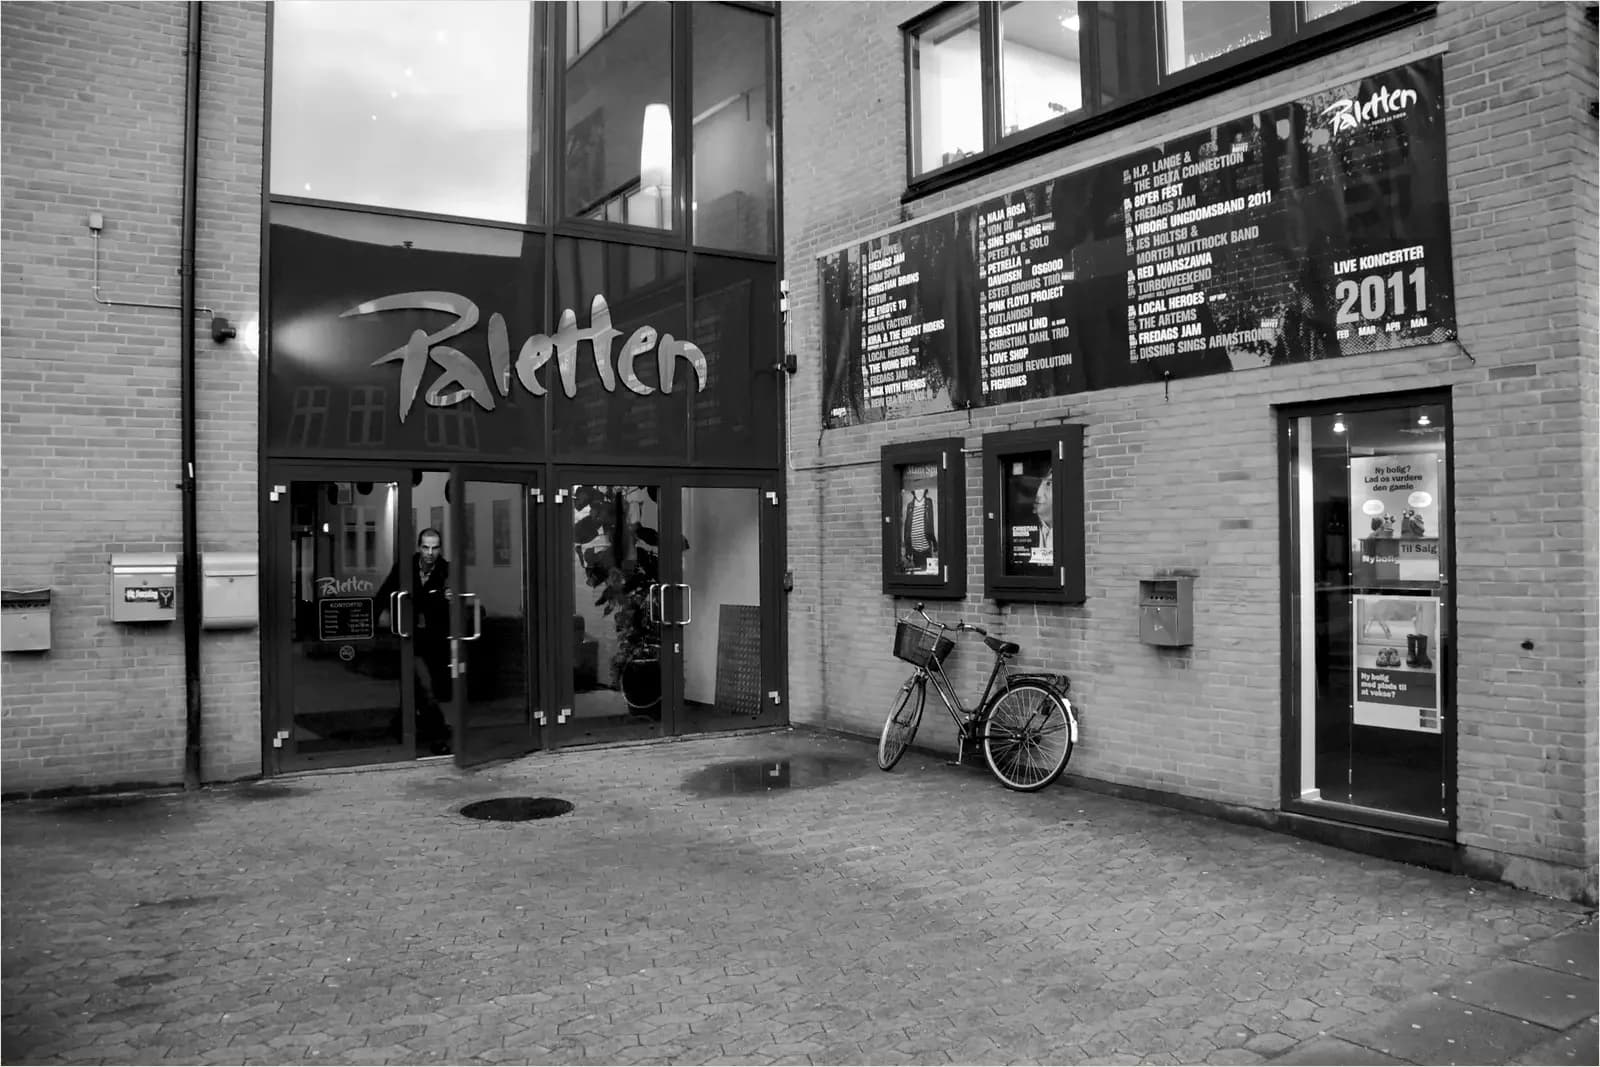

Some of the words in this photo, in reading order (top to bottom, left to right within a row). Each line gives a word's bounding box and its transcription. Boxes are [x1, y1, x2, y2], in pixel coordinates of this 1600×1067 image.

[1320, 85, 1417, 136] Paletten
[1133, 164, 1149, 179] H.P.
[1152, 153, 1182, 174] LANGE
[1184, 150, 1192, 163] &
[1134, 178, 1151, 193] THE
[1153, 170, 1180, 187] DELTA
[1182, 151, 1244, 178] CONNECTION
[1134, 192, 1160, 208] 80'ER
[1161, 183, 1183, 199] FEST
[1006, 202, 1026, 218] ROSA
[1135, 200, 1174, 222] FREDAGS
[1176, 194, 1196, 210] JAM
[1135, 218, 1168, 236] VIBORG
[1170, 197, 1245, 227] UNGDOMSBAND
[1247, 190, 1272, 208] 2011
[987, 222, 1002, 236] VON
[987, 235, 1004, 249] SING
[1005, 229, 1022, 244] SING
[1023, 223, 1041, 238] SING
[1136, 237, 1150, 251] JES
[1153, 227, 1188, 246] HOLTSØ
[1190, 225, 1199, 237] &
[987, 246, 1009, 261] PETER
[1020, 241, 1028, 252] G.
[1029, 235, 1049, 250] SOLO
[1136, 247, 1174, 265] MORTEN
[1176, 232, 1228, 256] WITTROCK
[1231, 226, 1259, 244] BAND
[893, 252, 905, 265] JAM
[988, 256, 1022, 274] PETRELLA
[1137, 265, 1154, 280] RED
[1156, 251, 1213, 276] WARSZAWA
[1334, 257, 1358, 275] LIVE
[1359, 245, 1425, 271] KONCERTER
[988, 269, 1022, 287] DAVIDSEN
[1031, 258, 1063, 276] OSGOOD
[1138, 267, 1212, 294] TURBOWEEKEND
[988, 285, 1009, 300] ESTER
[1042, 272, 1060, 287] TRIO
[1335, 266, 1427, 325] 2011
[898, 299, 907, 311] TO
[988, 299, 1005, 313] PINK
[1006, 293, 1029, 309] FLOYD
[1030, 285, 1064, 303] PROJECT
[1138, 299, 1167, 316] LOCAL
[1168, 291, 1205, 310] HEROES
[886, 315, 912, 329] FACTORY
[988, 306, 1033, 326] OUTLANDISH
[988, 320, 1027, 338] SEBASTIAN
[1029, 316, 1048, 331] LIND
[1138, 316, 1156, 330] THE
[1158, 308, 1197, 326] ARTEMS
[1358, 325, 1376, 337] MAR
[1385, 321, 1401, 333] APR
[1410, 317, 1428, 329] MAJ
[889, 330, 901, 341] THE
[901, 325, 921, 338] GHOST
[989, 335, 1027, 352] CHRISTINA
[1029, 330, 1050, 344] DAHL
[1051, 326, 1070, 340] TRIO
[1138, 326, 1179, 345] FREDAGS
[1181, 322, 1202, 338] JAM
[338, 290, 708, 424] Paletten
[868, 350, 886, 362] LOCAL
[887, 345, 909, 358] HEROES
[989, 351, 1008, 365] LOVE
[1009, 347, 1029, 361] SHOP
[1139, 343, 1175, 360] DISSING
[1177, 337, 1207, 354] SINGS
[868, 363, 881, 374] THE
[895, 369, 908, 381] JAM
[990, 362, 1024, 378] SHOTGUN
[1025, 353, 1072, 372] REVOLUTION
[884, 382, 901, 394] WITH
[902, 377, 926, 391] FRIENDS
[990, 374, 1027, 391] FIGURINES
[1364, 475, 1378, 483] Lad
[1392, 474, 1423, 482] vurdere
[1375, 467, 1384, 475] Ny
[1386, 464, 1411, 474] bolig?
[1389, 483, 1414, 492] gamle
[1401, 544, 1413, 553] Til
[1414, 543, 1438, 555] Salg
[316, 576, 373, 596] Paletten
[1361, 672, 1370, 681] Ny
[1371, 673, 1390, 683] bolig
[1361, 681, 1376, 689] med
[1361, 688, 1369, 696] at
[1370, 690, 1396, 698] vokse?
